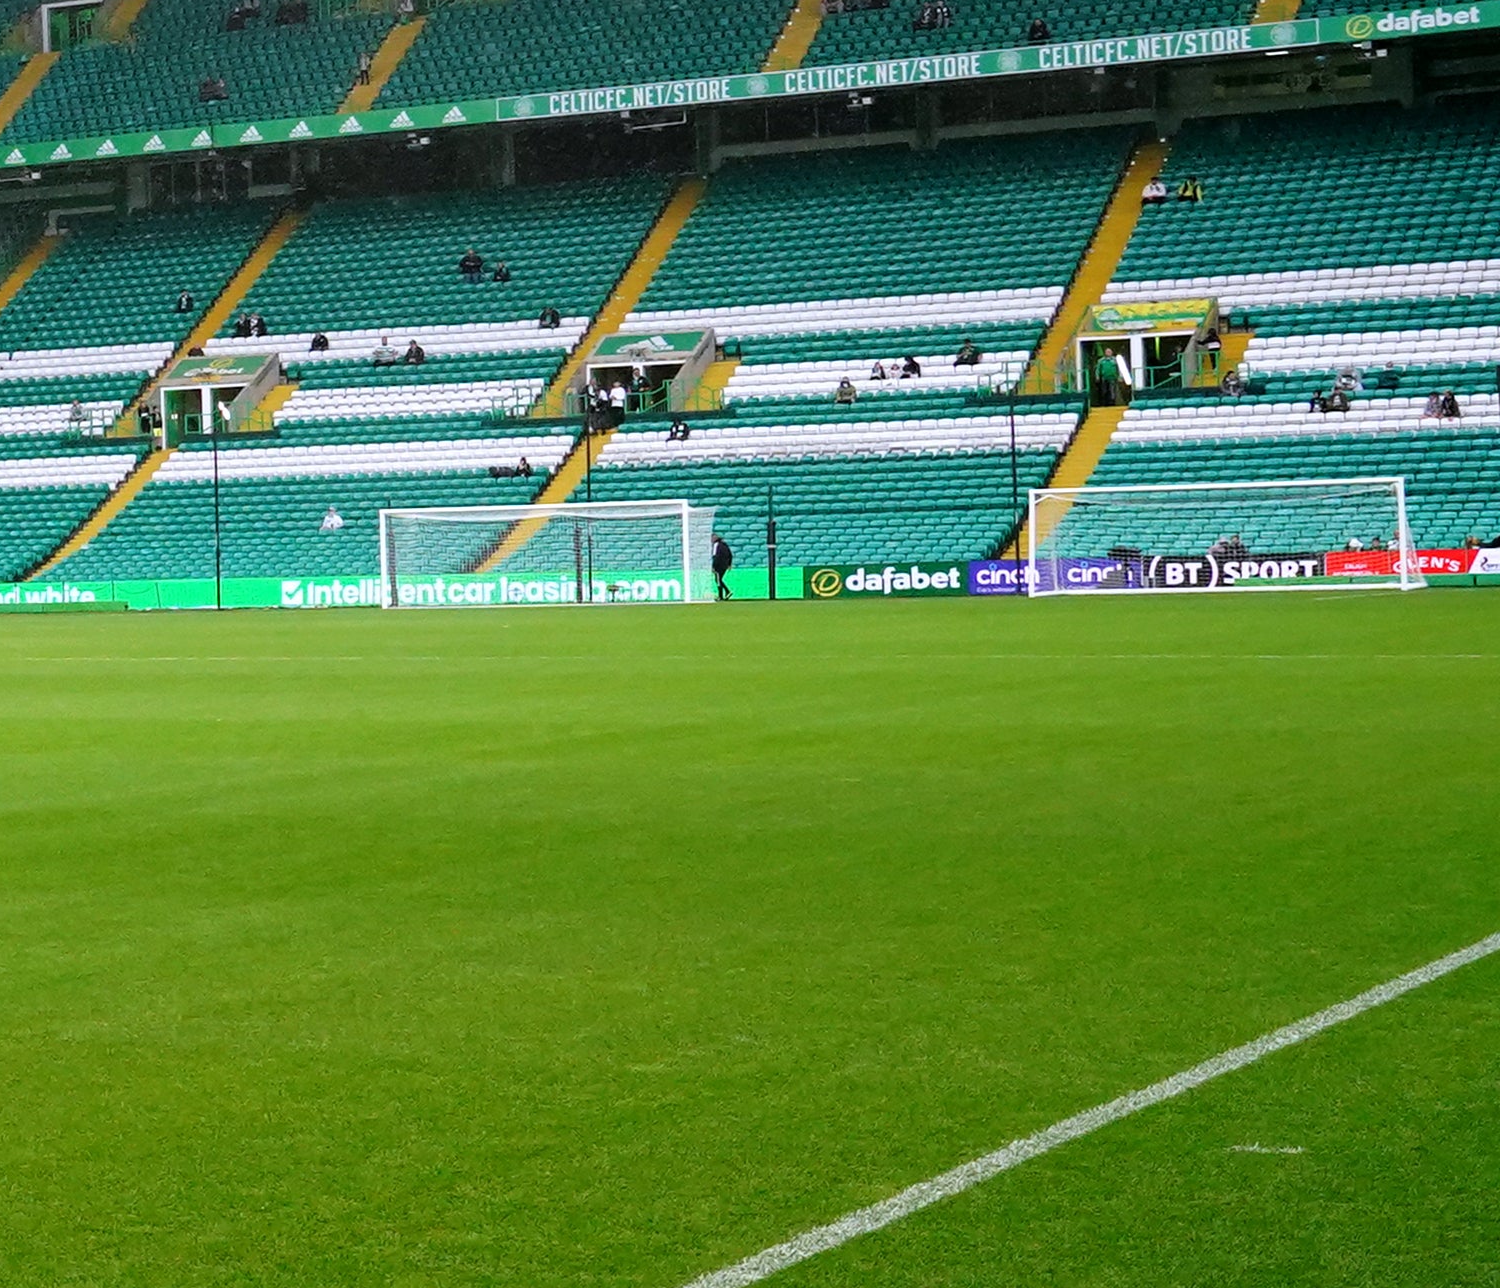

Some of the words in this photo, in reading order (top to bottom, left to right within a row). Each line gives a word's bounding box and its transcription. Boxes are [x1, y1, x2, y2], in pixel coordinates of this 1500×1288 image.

[1376, 6, 1480, 33] dafabet
[1039, 27, 1251, 69] CELTICFC.NET/STORE
[785, 55, 980, 94] CELTICFC.NET/STORE
[549, 78, 731, 116] CELTICFC.NET/STORE
[845, 566, 961, 595] dafabet
[976, 562, 1041, 586] cinch
[1222, 560, 1318, 584] SPORT
